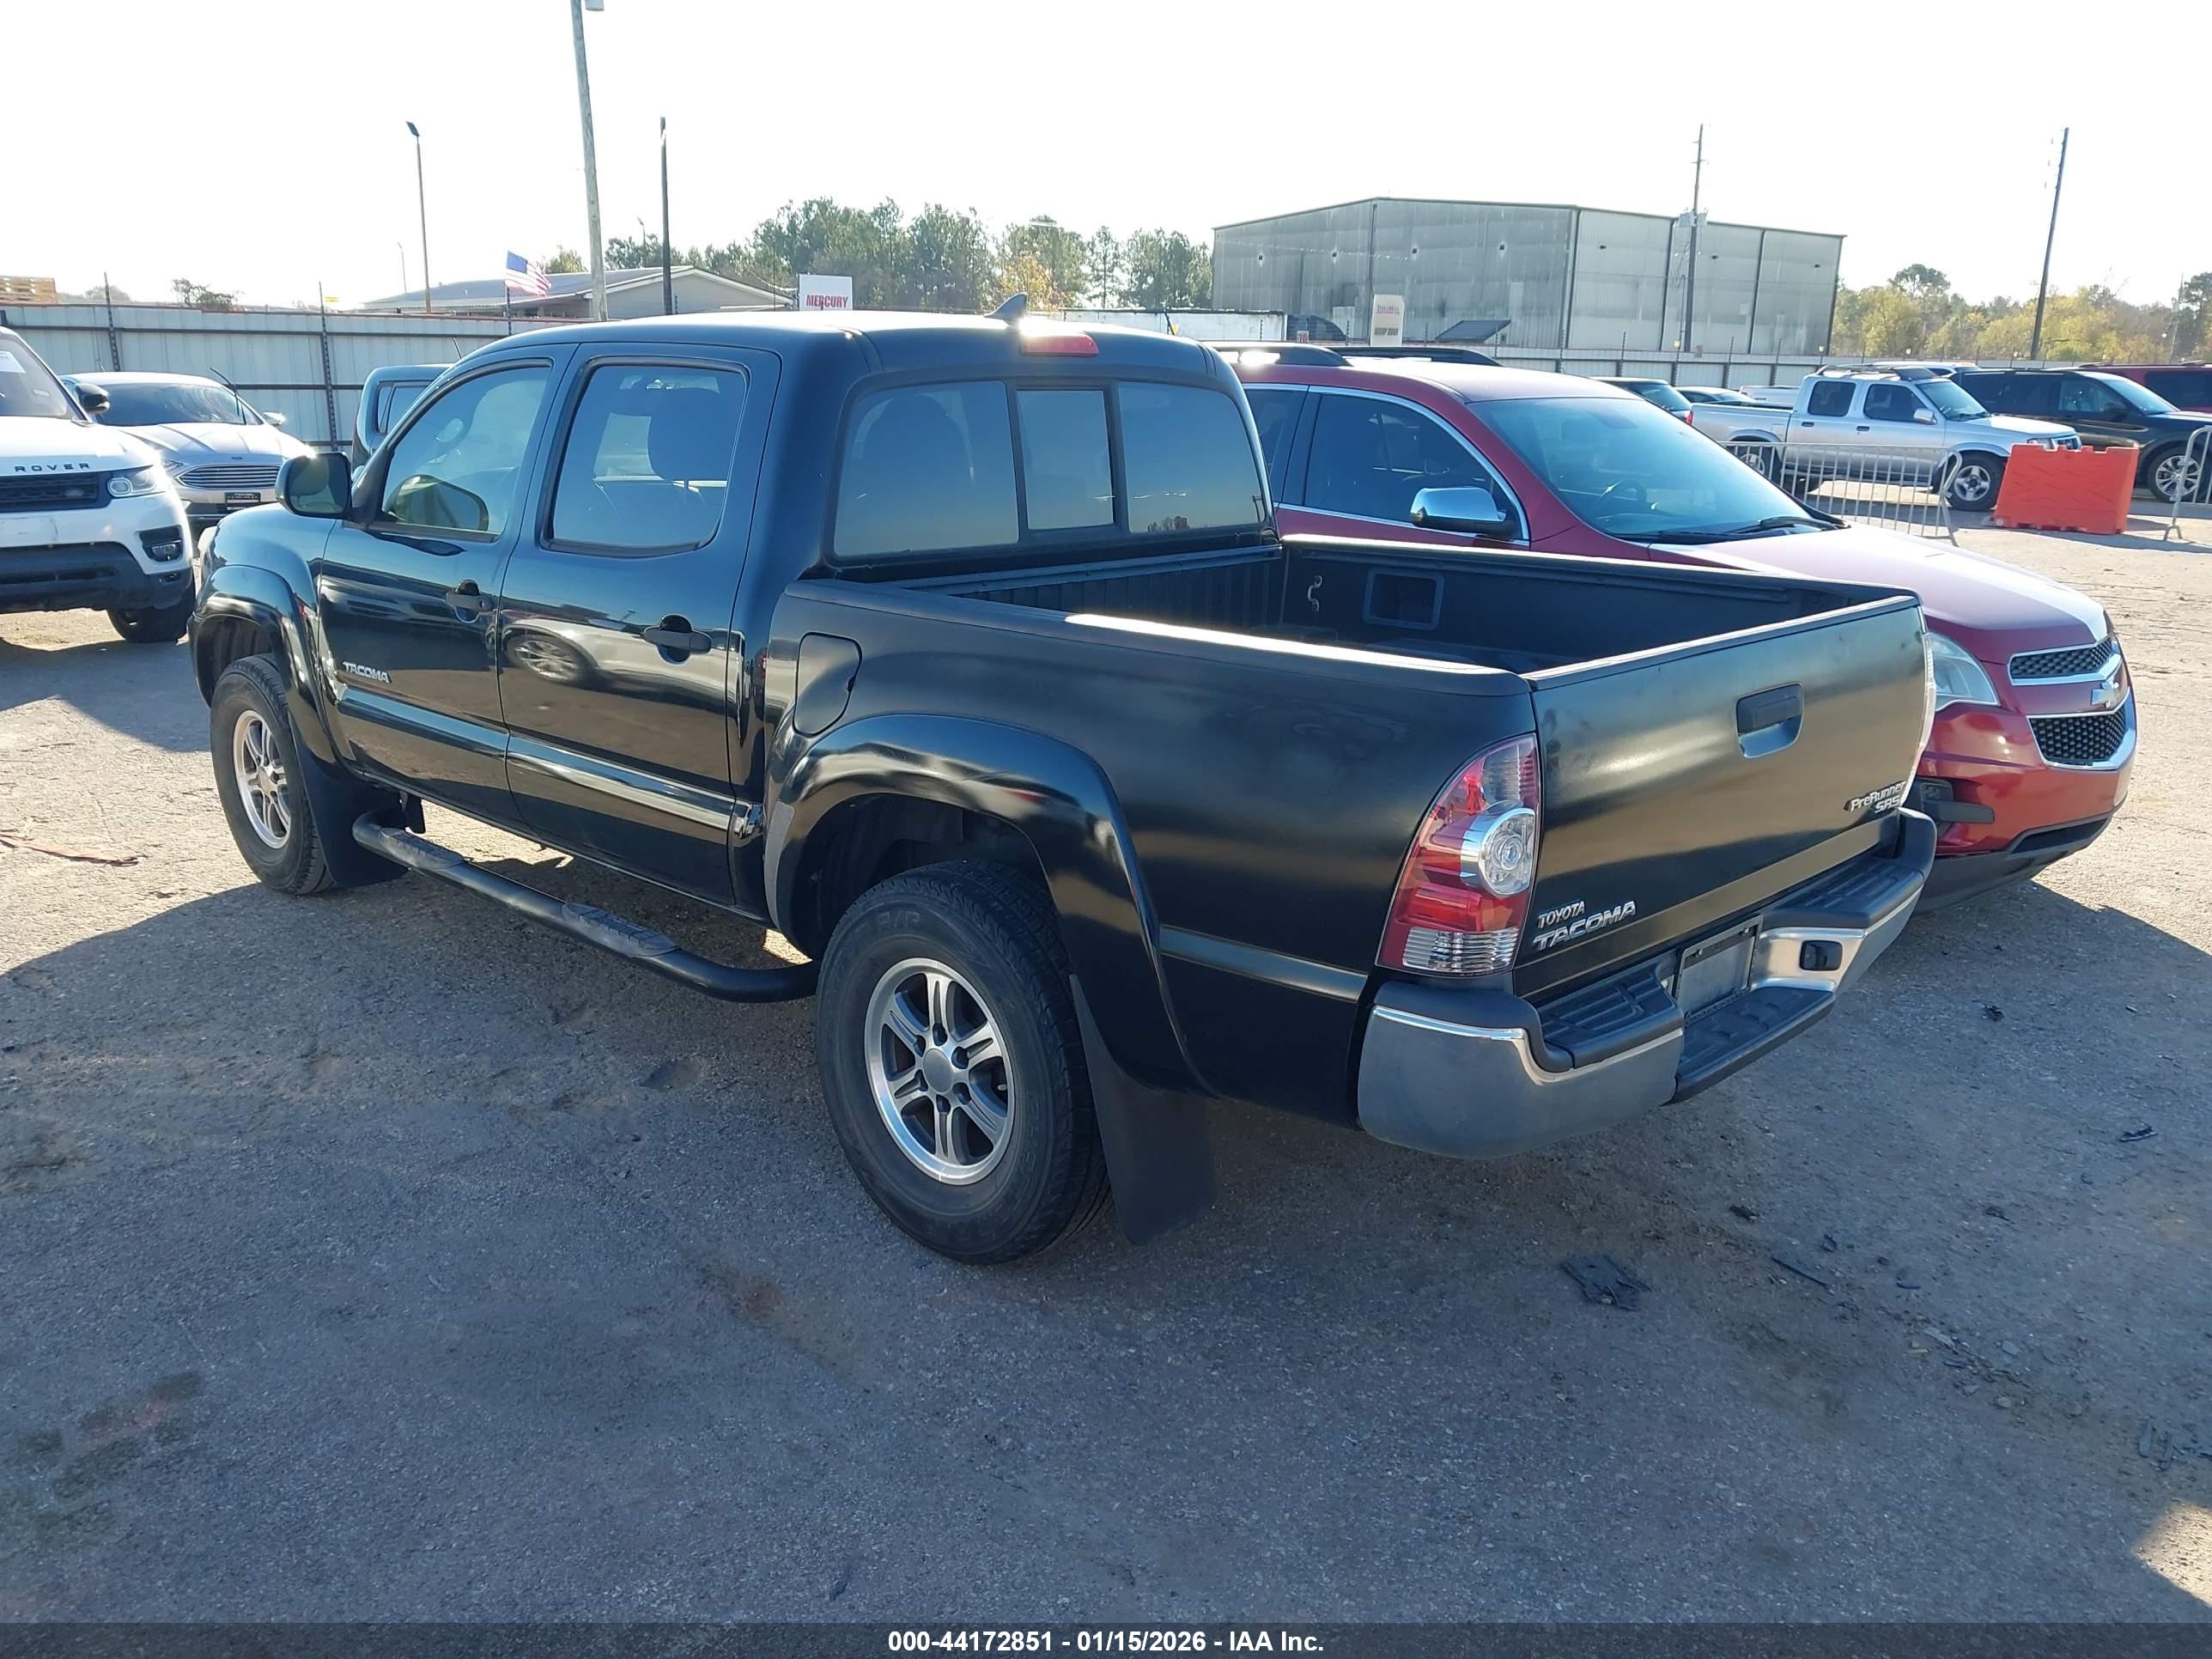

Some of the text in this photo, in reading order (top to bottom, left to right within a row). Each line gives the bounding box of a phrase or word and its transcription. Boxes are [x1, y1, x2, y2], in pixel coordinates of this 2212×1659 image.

[806, 295, 848, 309] MERCURY
[14, 462, 91, 473] ROVER
[342, 660, 392, 684] TACOMA
[1850, 780, 1907, 812] PreRunner
[1532, 900, 1637, 951] TACOMA
[1537, 900, 1586, 929] TOYOTA
